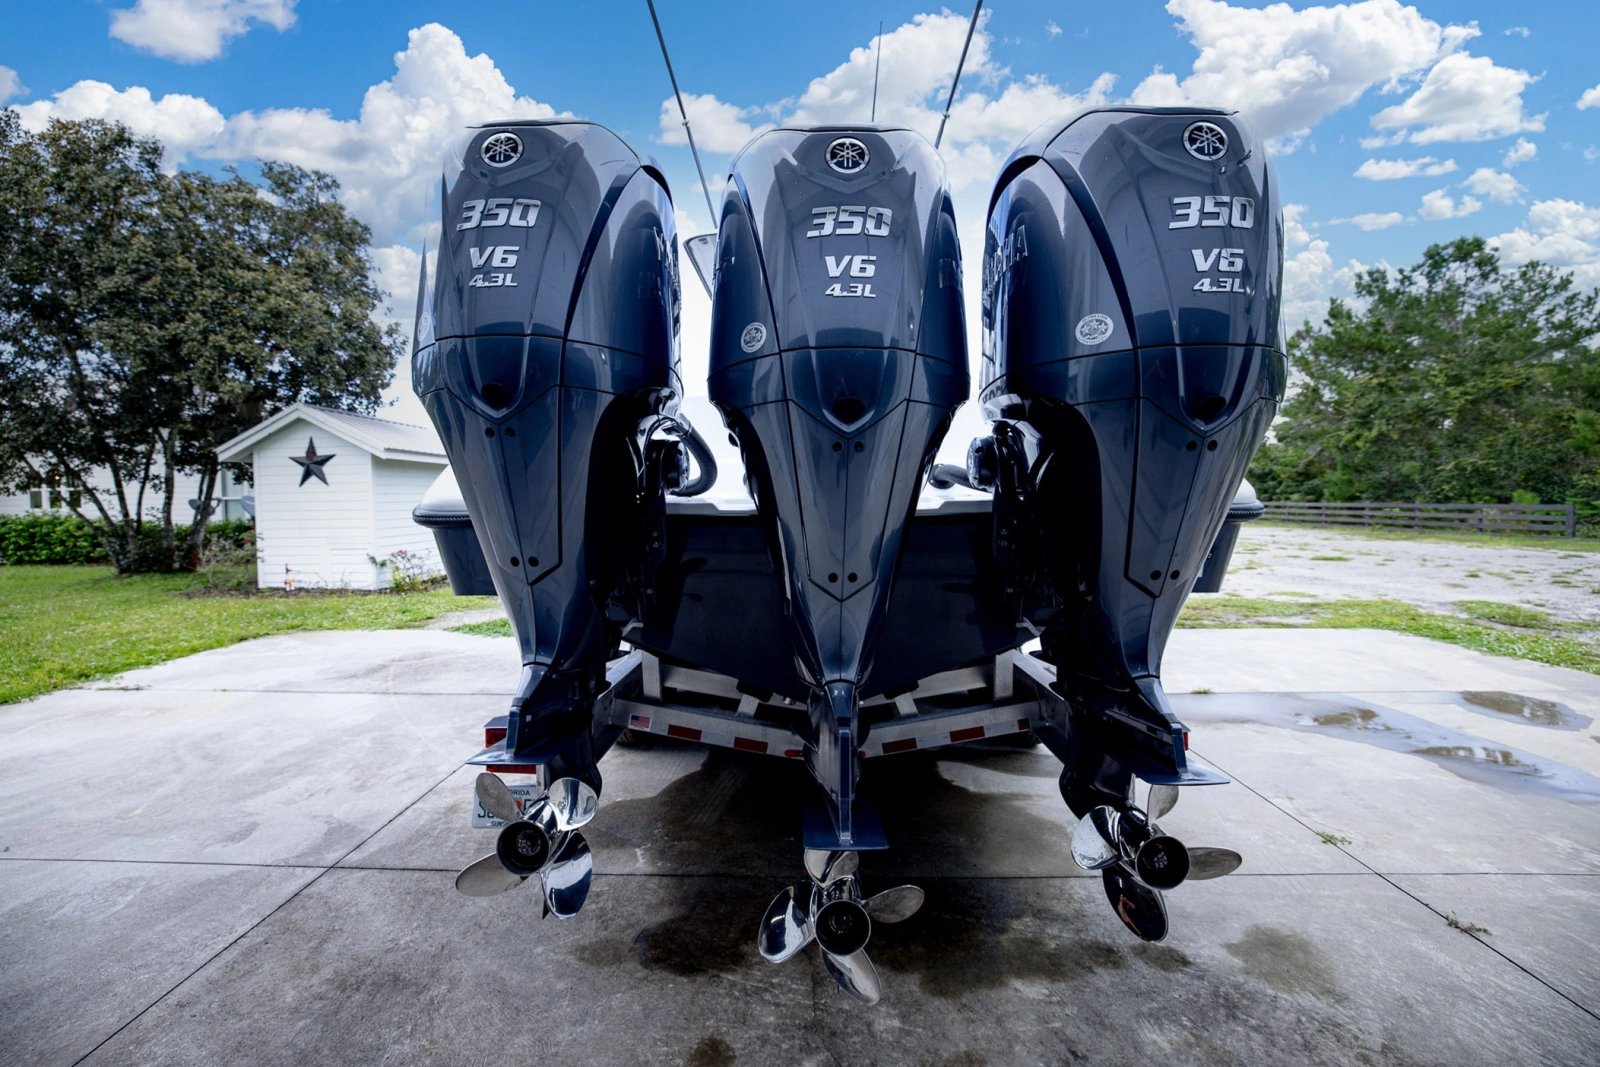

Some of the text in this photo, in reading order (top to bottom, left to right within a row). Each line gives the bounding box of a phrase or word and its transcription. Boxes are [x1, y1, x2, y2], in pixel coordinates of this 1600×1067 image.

[456, 198, 541, 231] 350
[806, 205, 893, 237] 350
[1168, 195, 1255, 229] 350
[469, 246, 520, 269] V6
[824, 254, 877, 278] V6
[1191, 248, 1244, 272] V6
[468, 273, 518, 288] 4.3L
[825, 283, 876, 298] 4.3L
[1193, 278, 1244, 292] 4.3L
